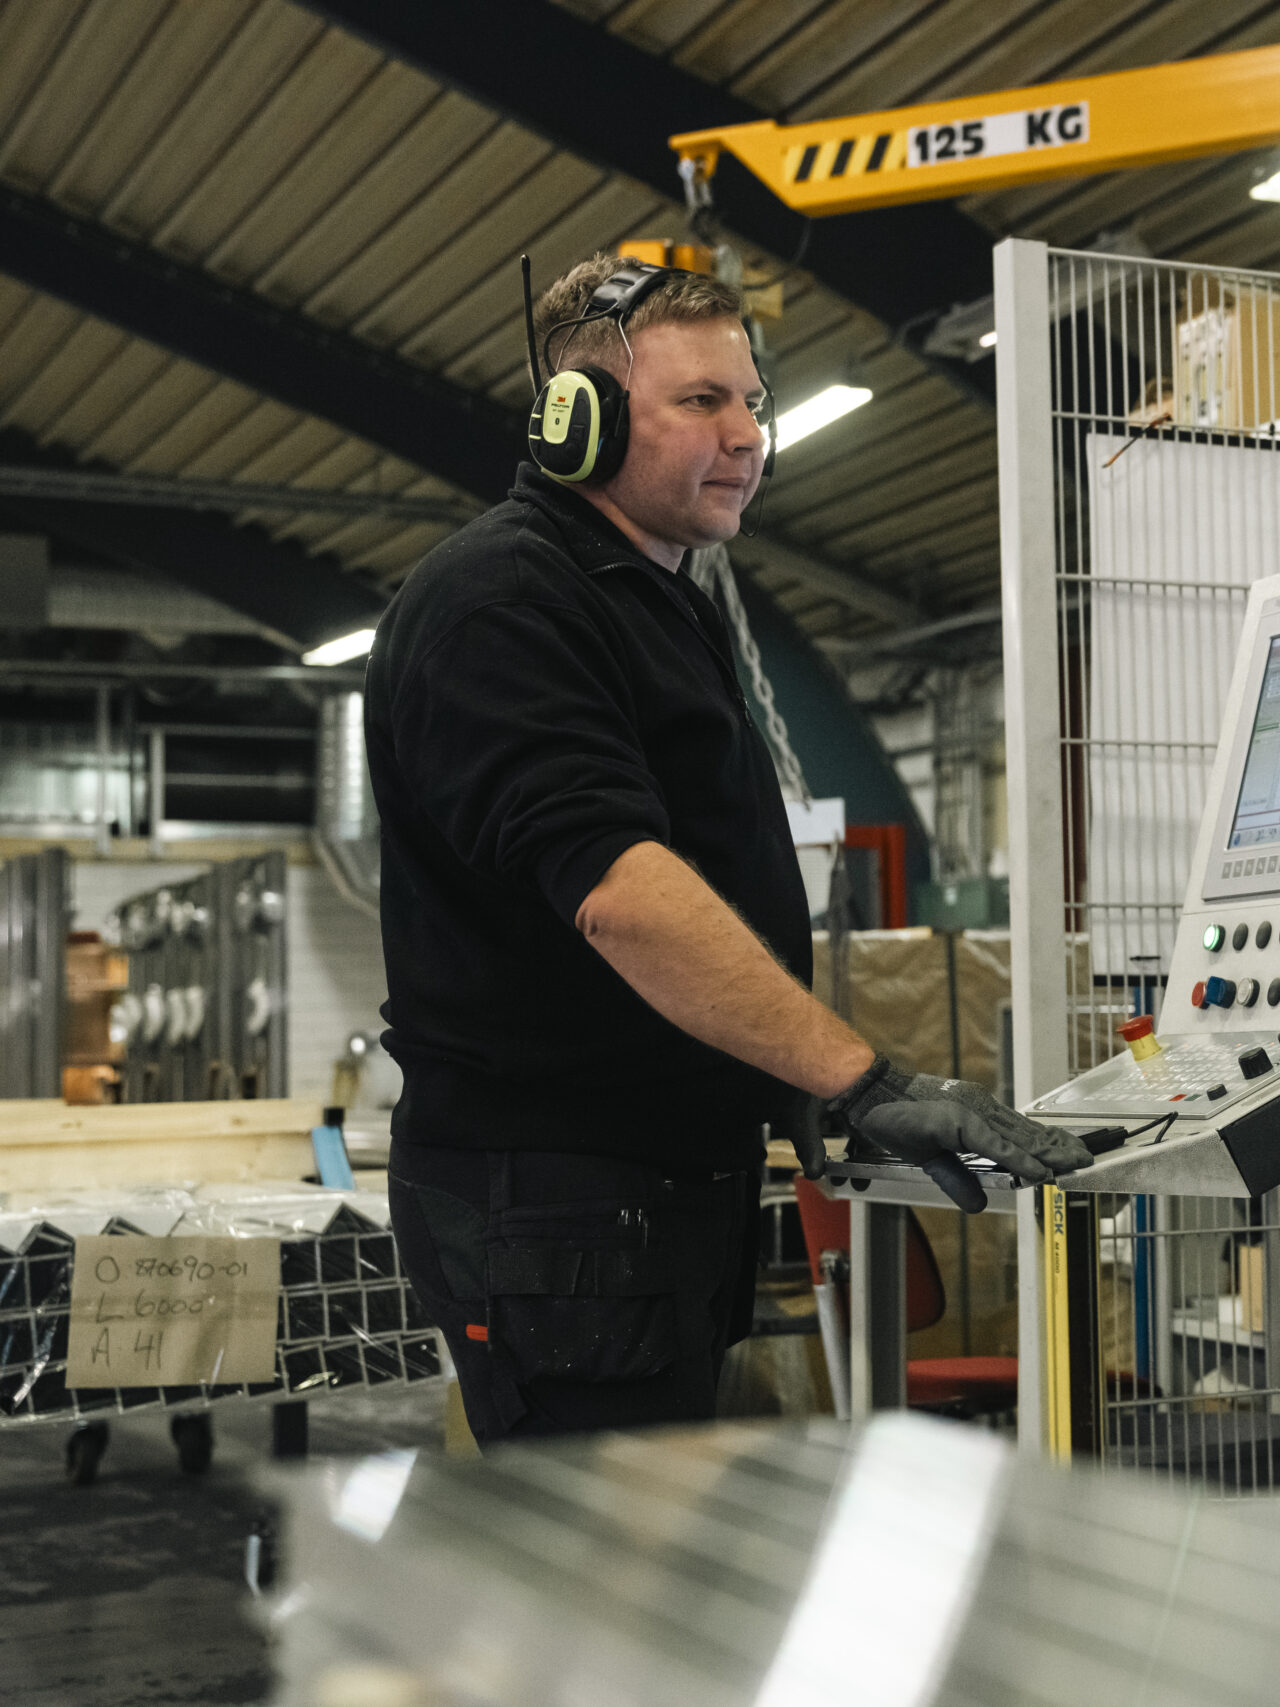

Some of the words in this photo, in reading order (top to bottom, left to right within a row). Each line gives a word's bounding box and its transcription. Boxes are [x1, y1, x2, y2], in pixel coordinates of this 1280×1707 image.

[916, 122, 984, 162] 125
[1028, 105, 1081, 146] KG
[1054, 1191, 1064, 1235] SICK
[96, 1292, 124, 1323] L
[135, 1288, 203, 1317] 6000
[91, 1327, 110, 1367] A
[134, 1329, 164, 1370] 41
